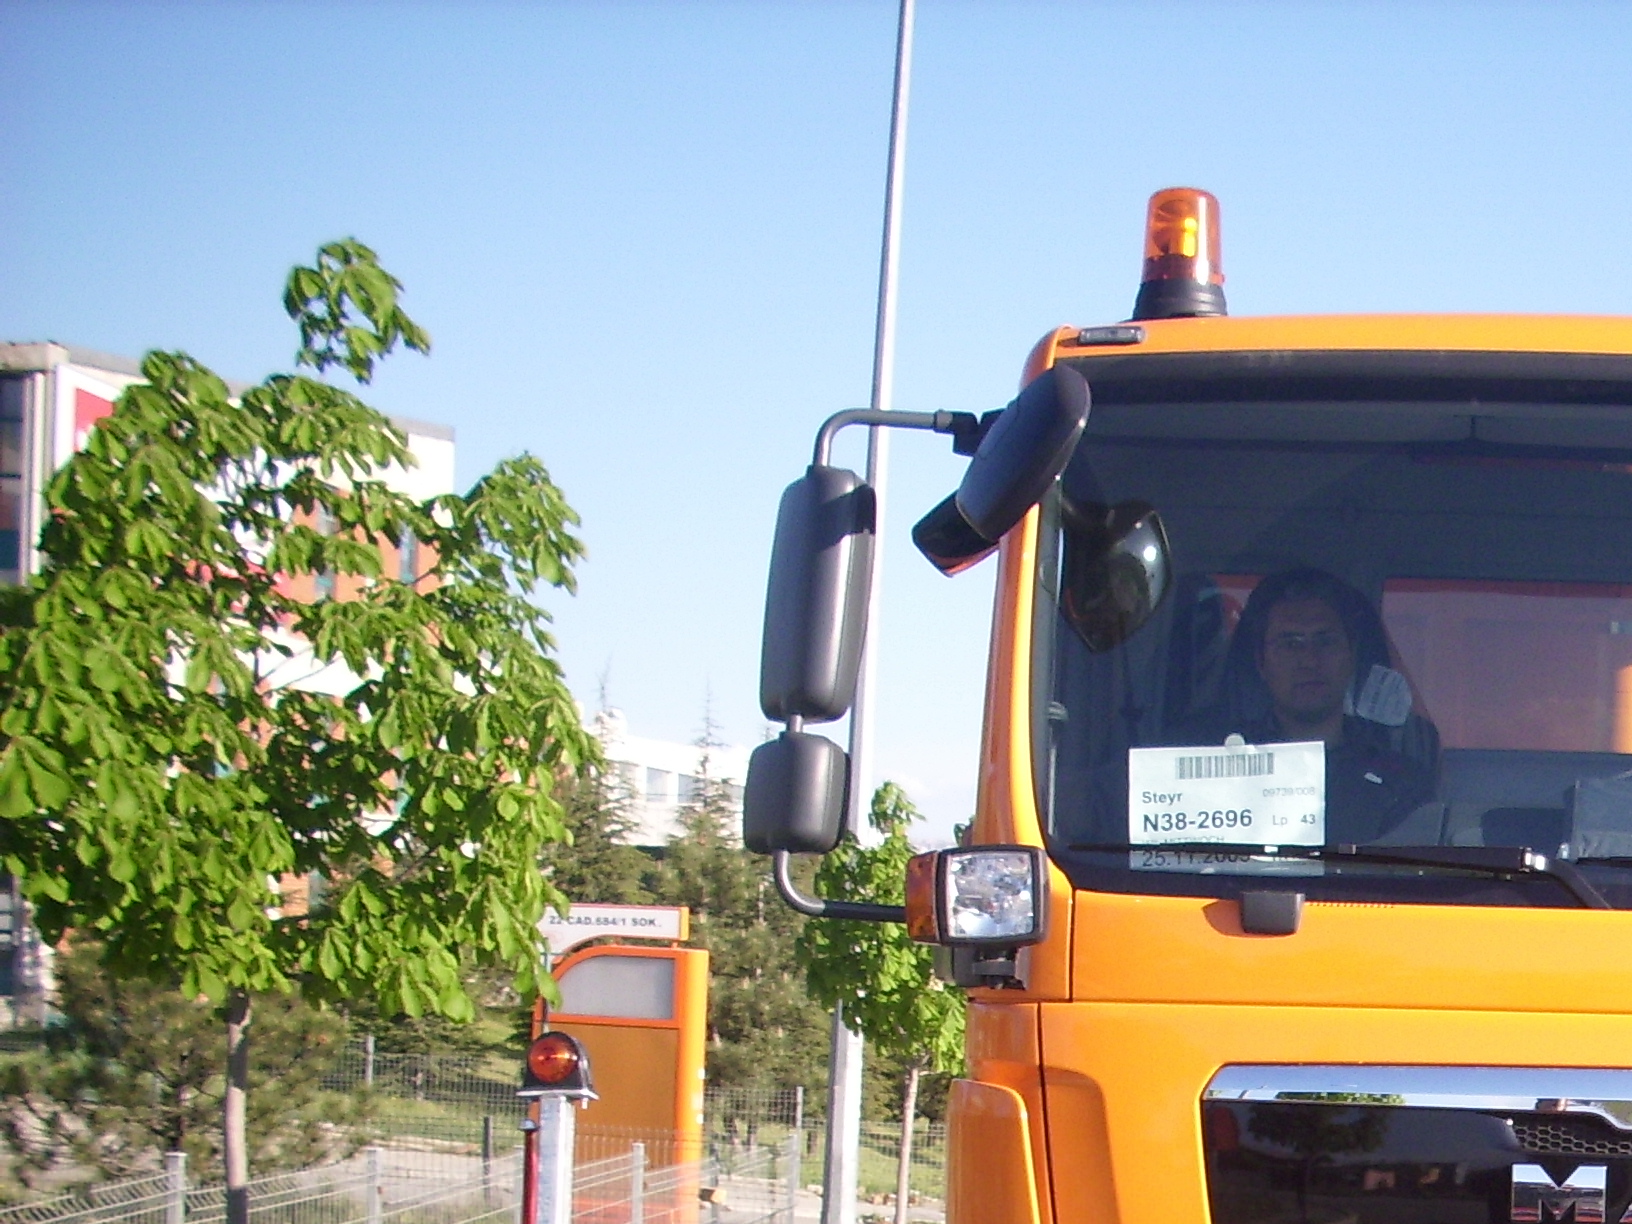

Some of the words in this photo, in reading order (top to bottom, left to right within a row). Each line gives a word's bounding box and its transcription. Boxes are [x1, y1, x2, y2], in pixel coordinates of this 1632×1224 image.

[1141, 791, 1183, 804] Steyr
[1142, 809, 1253, 832] N38-2696
[1300, 813, 1316, 825] 43
